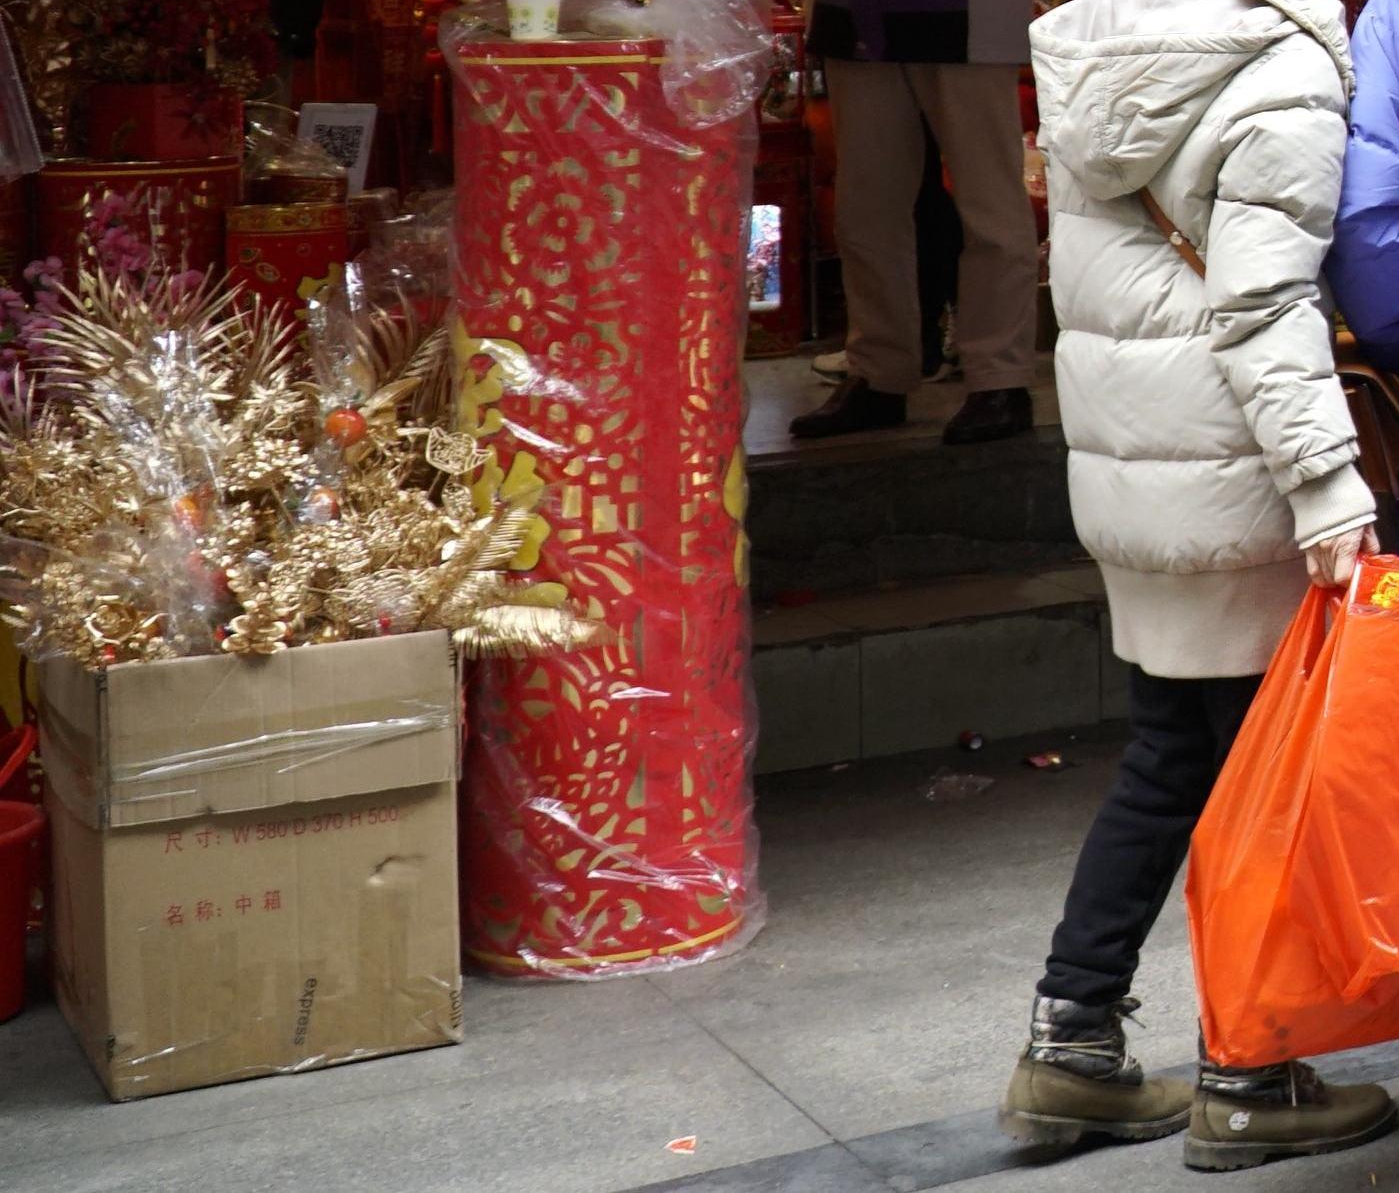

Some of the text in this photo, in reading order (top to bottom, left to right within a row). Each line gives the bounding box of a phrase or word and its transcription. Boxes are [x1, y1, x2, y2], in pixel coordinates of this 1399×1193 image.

[232, 825, 249, 844] W
[256, 820, 288, 841] 580
[294, 817, 306, 835] D
[312, 812, 343, 833] 370
[294, 977, 318, 1047] express
